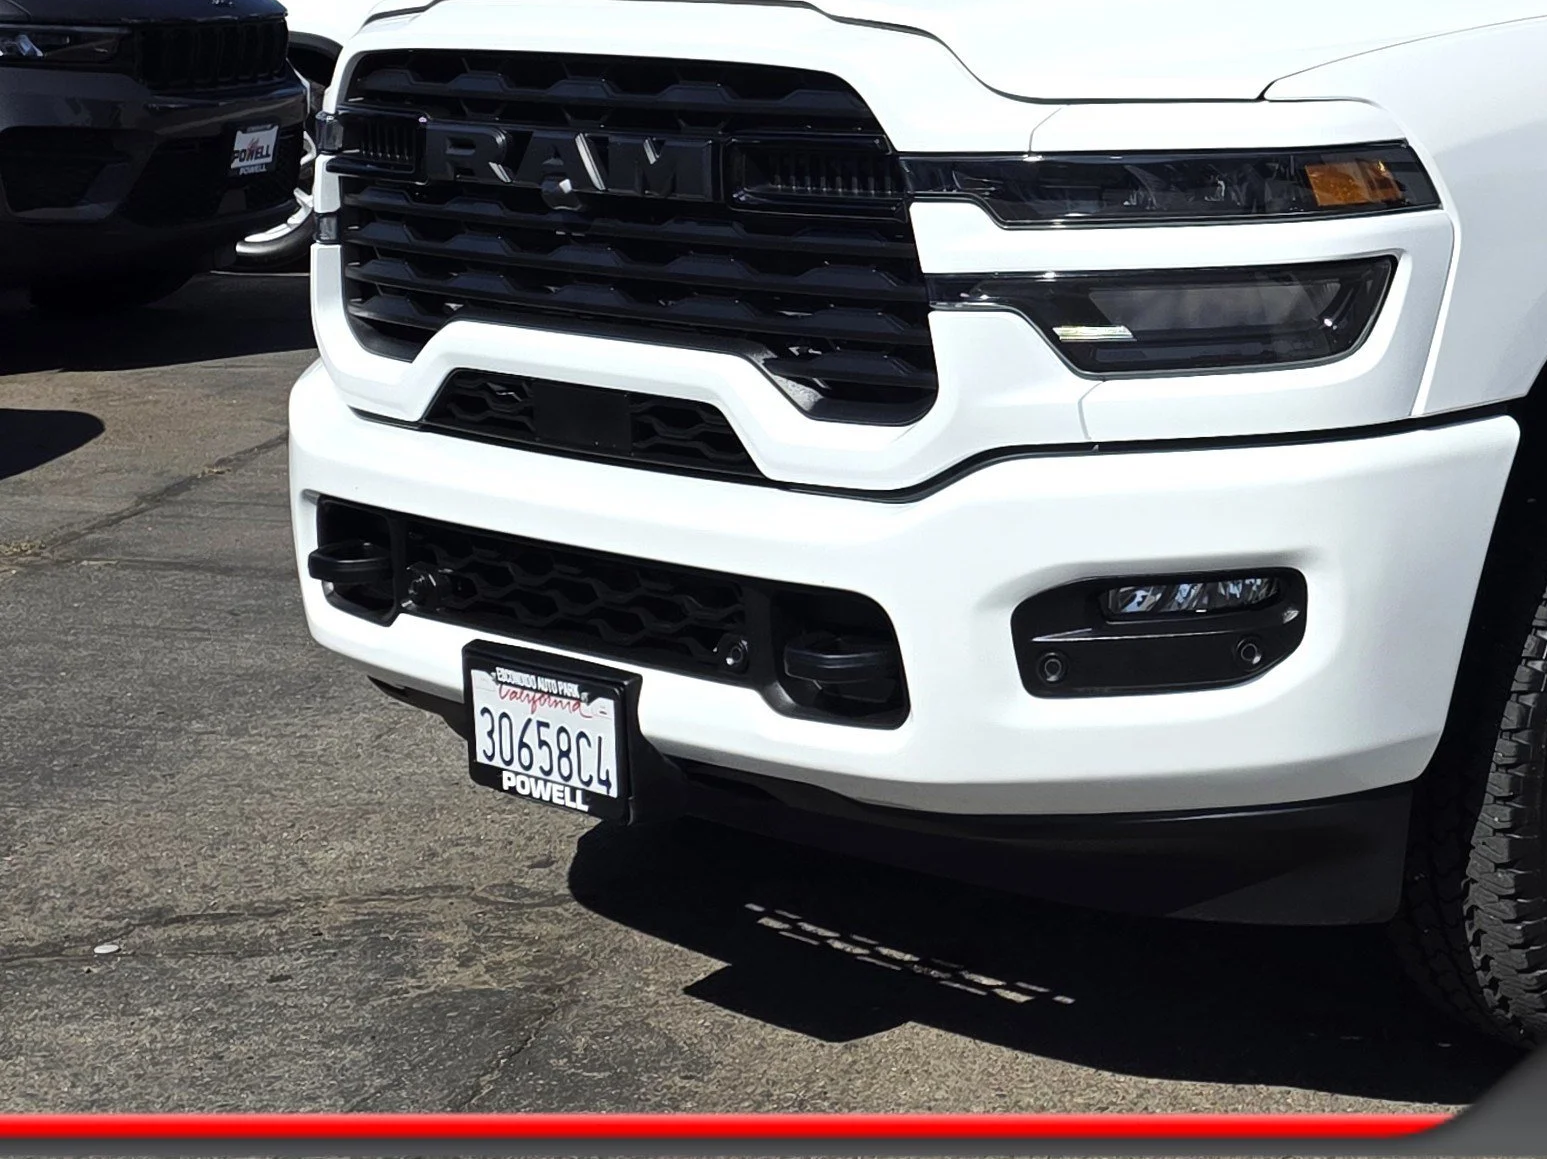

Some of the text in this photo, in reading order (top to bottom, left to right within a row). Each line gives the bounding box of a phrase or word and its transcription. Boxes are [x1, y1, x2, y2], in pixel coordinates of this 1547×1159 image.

[427, 123, 712, 201] RAM
[499, 683, 592, 719] California
[537, 676, 557, 694] AUTO
[558, 681, 580, 699] PARK
[480, 706, 612, 795] 30658C4
[502, 770, 589, 812] POWELL
